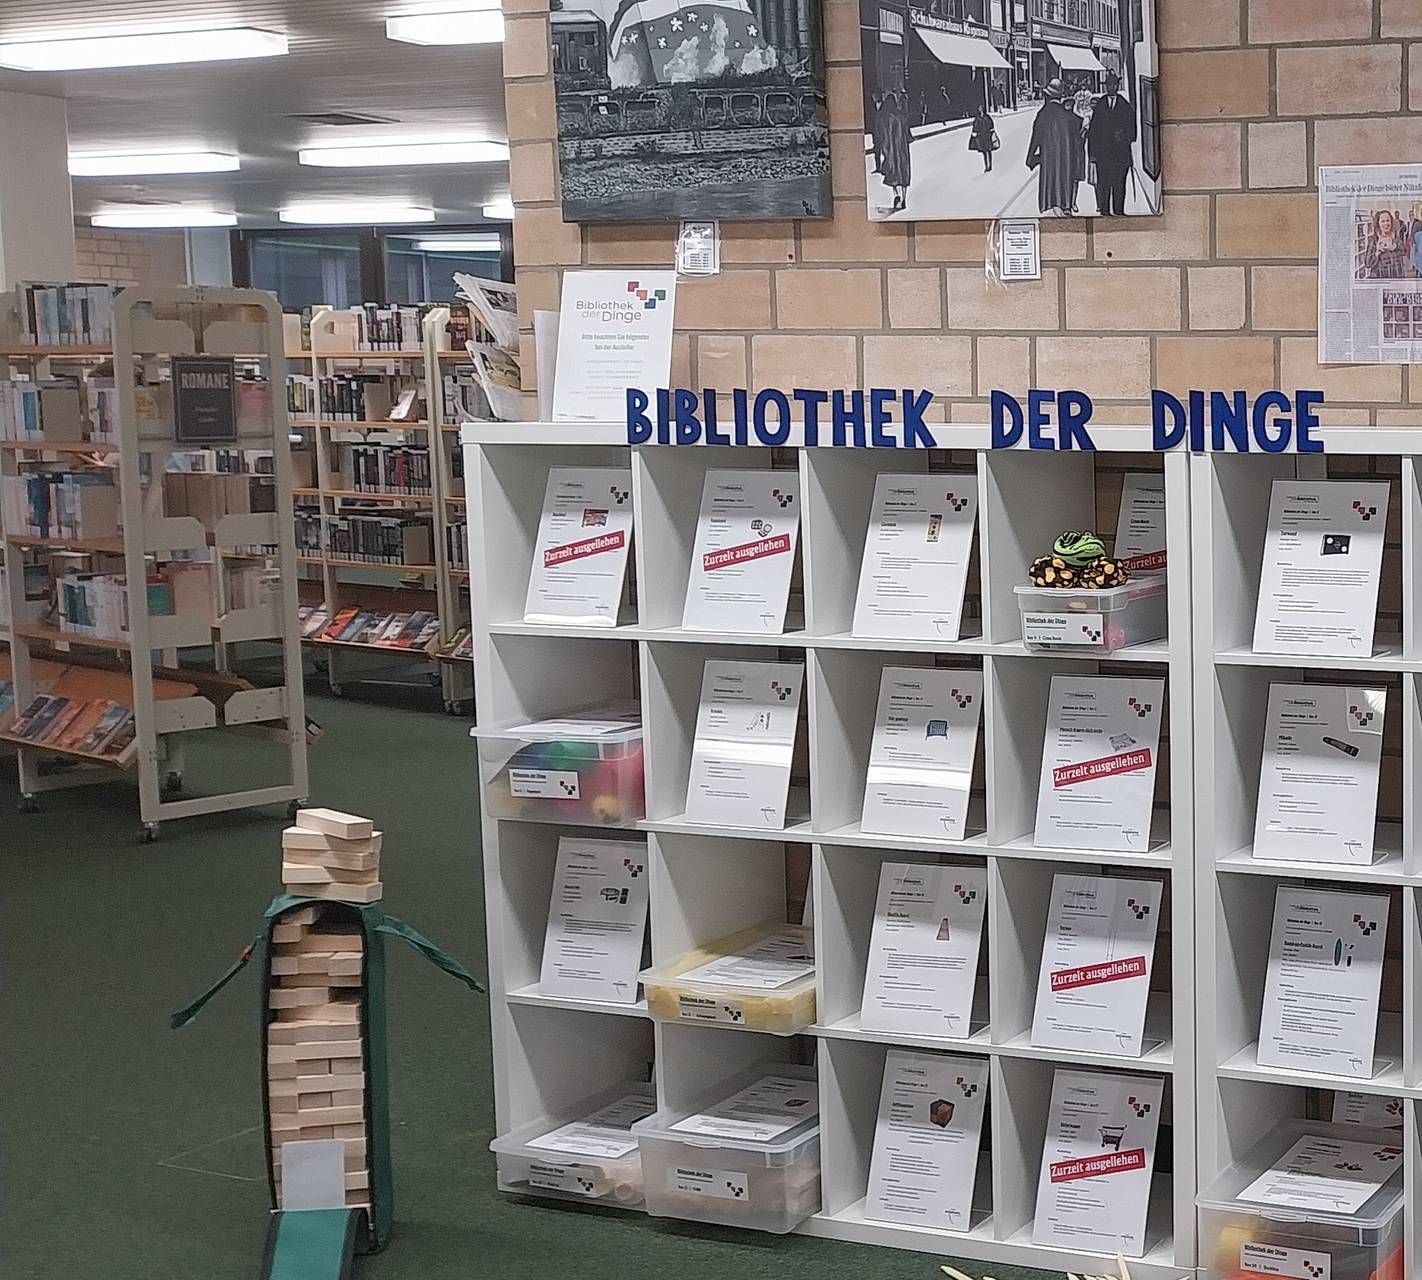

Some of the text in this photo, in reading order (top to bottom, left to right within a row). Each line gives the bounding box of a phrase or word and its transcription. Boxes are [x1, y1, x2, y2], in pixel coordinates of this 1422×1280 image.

[576, 300, 634, 310] Bibliothek
[582, 309, 642, 323] der Dinge
[181, 373, 229, 389] ROMANE
[626, 388, 1324, 454] BIBLIOTHEK DER DINGE
[545, 535, 620, 562] Zurzeit ausgeliehen
[704, 538, 784, 567] Zurzeit ausgeliehen
[1124, 554, 1156, 570] Zurzeit
[1054, 754, 1144, 782] Zurzeit ausgeliehen
[1051, 961, 1140, 986] Zurzeit ausgeliehen
[1051, 1153, 1139, 1178] Zurzeit ausgeliehen
